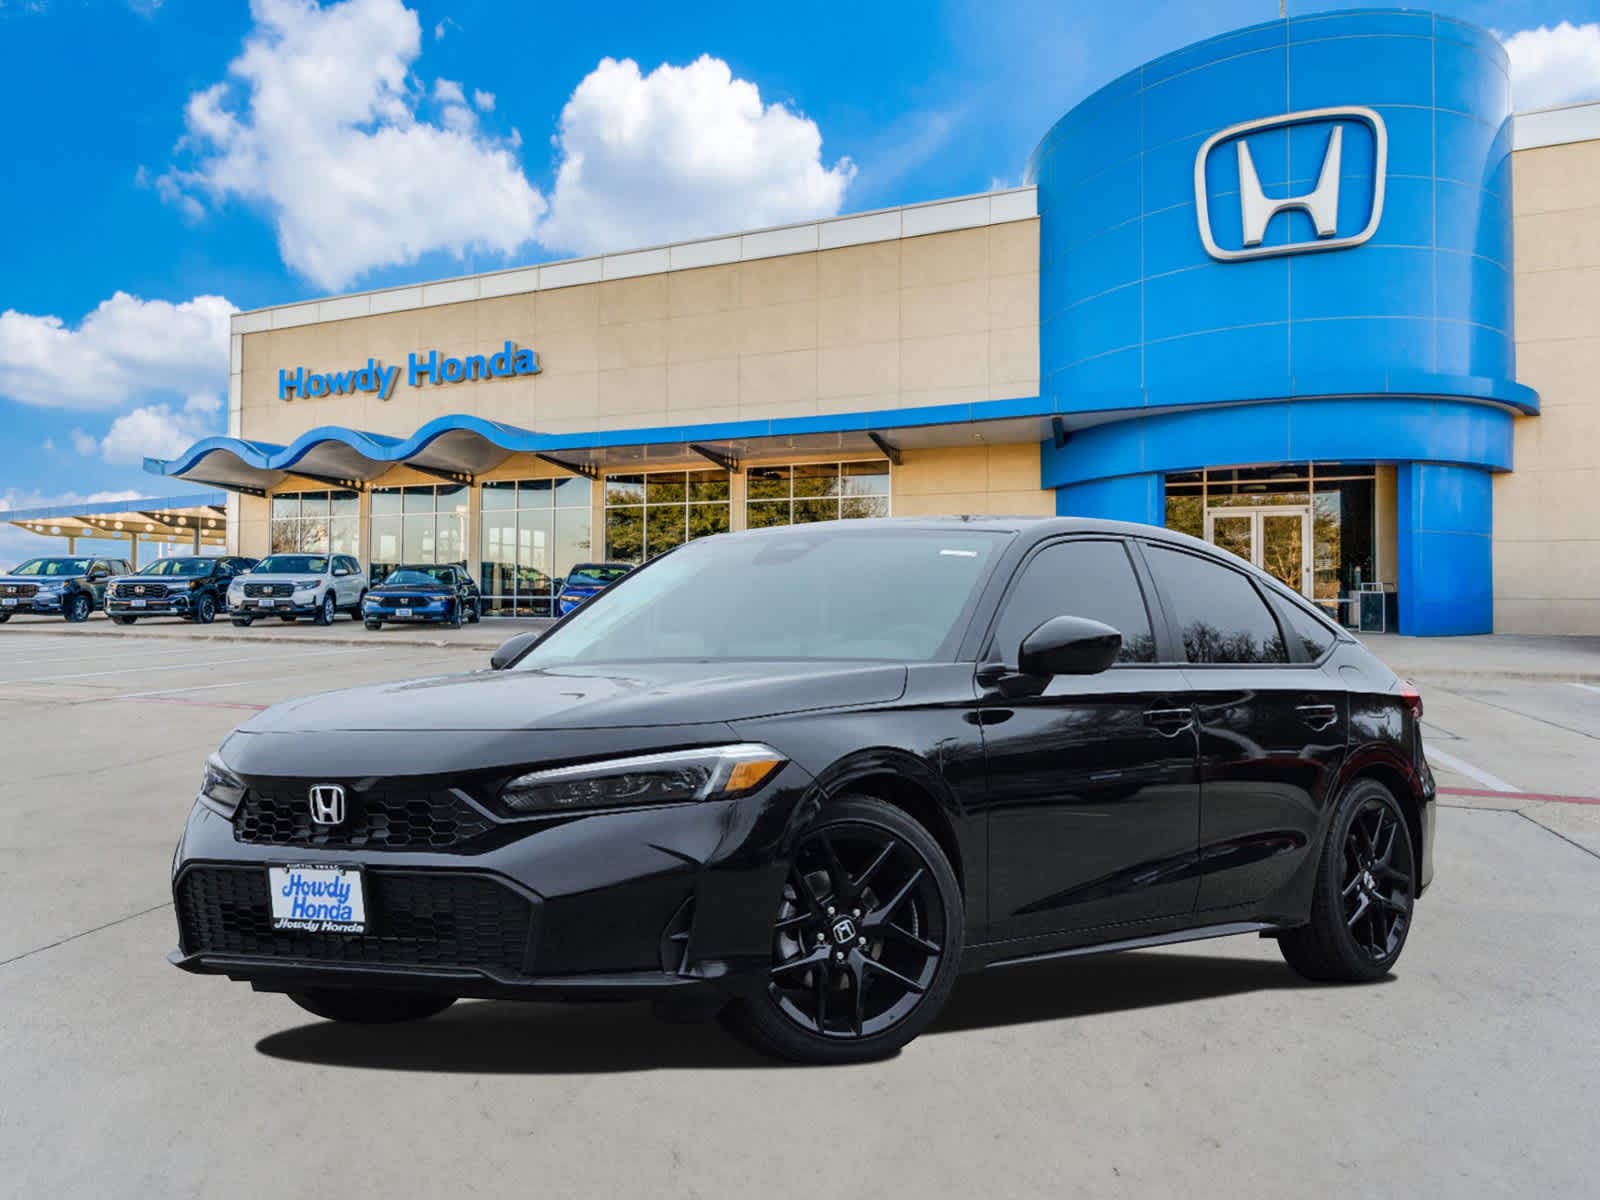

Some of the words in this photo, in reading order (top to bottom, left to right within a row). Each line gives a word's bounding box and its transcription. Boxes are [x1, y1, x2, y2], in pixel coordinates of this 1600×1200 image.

[279, 358, 398, 400] Howdy
[408, 340, 540, 387] Honda
[282, 873, 351, 904] Howdy
[291, 896, 353, 920] Honda
[274, 918, 320, 932] Howdy
[321, 921, 364, 933] Honda
